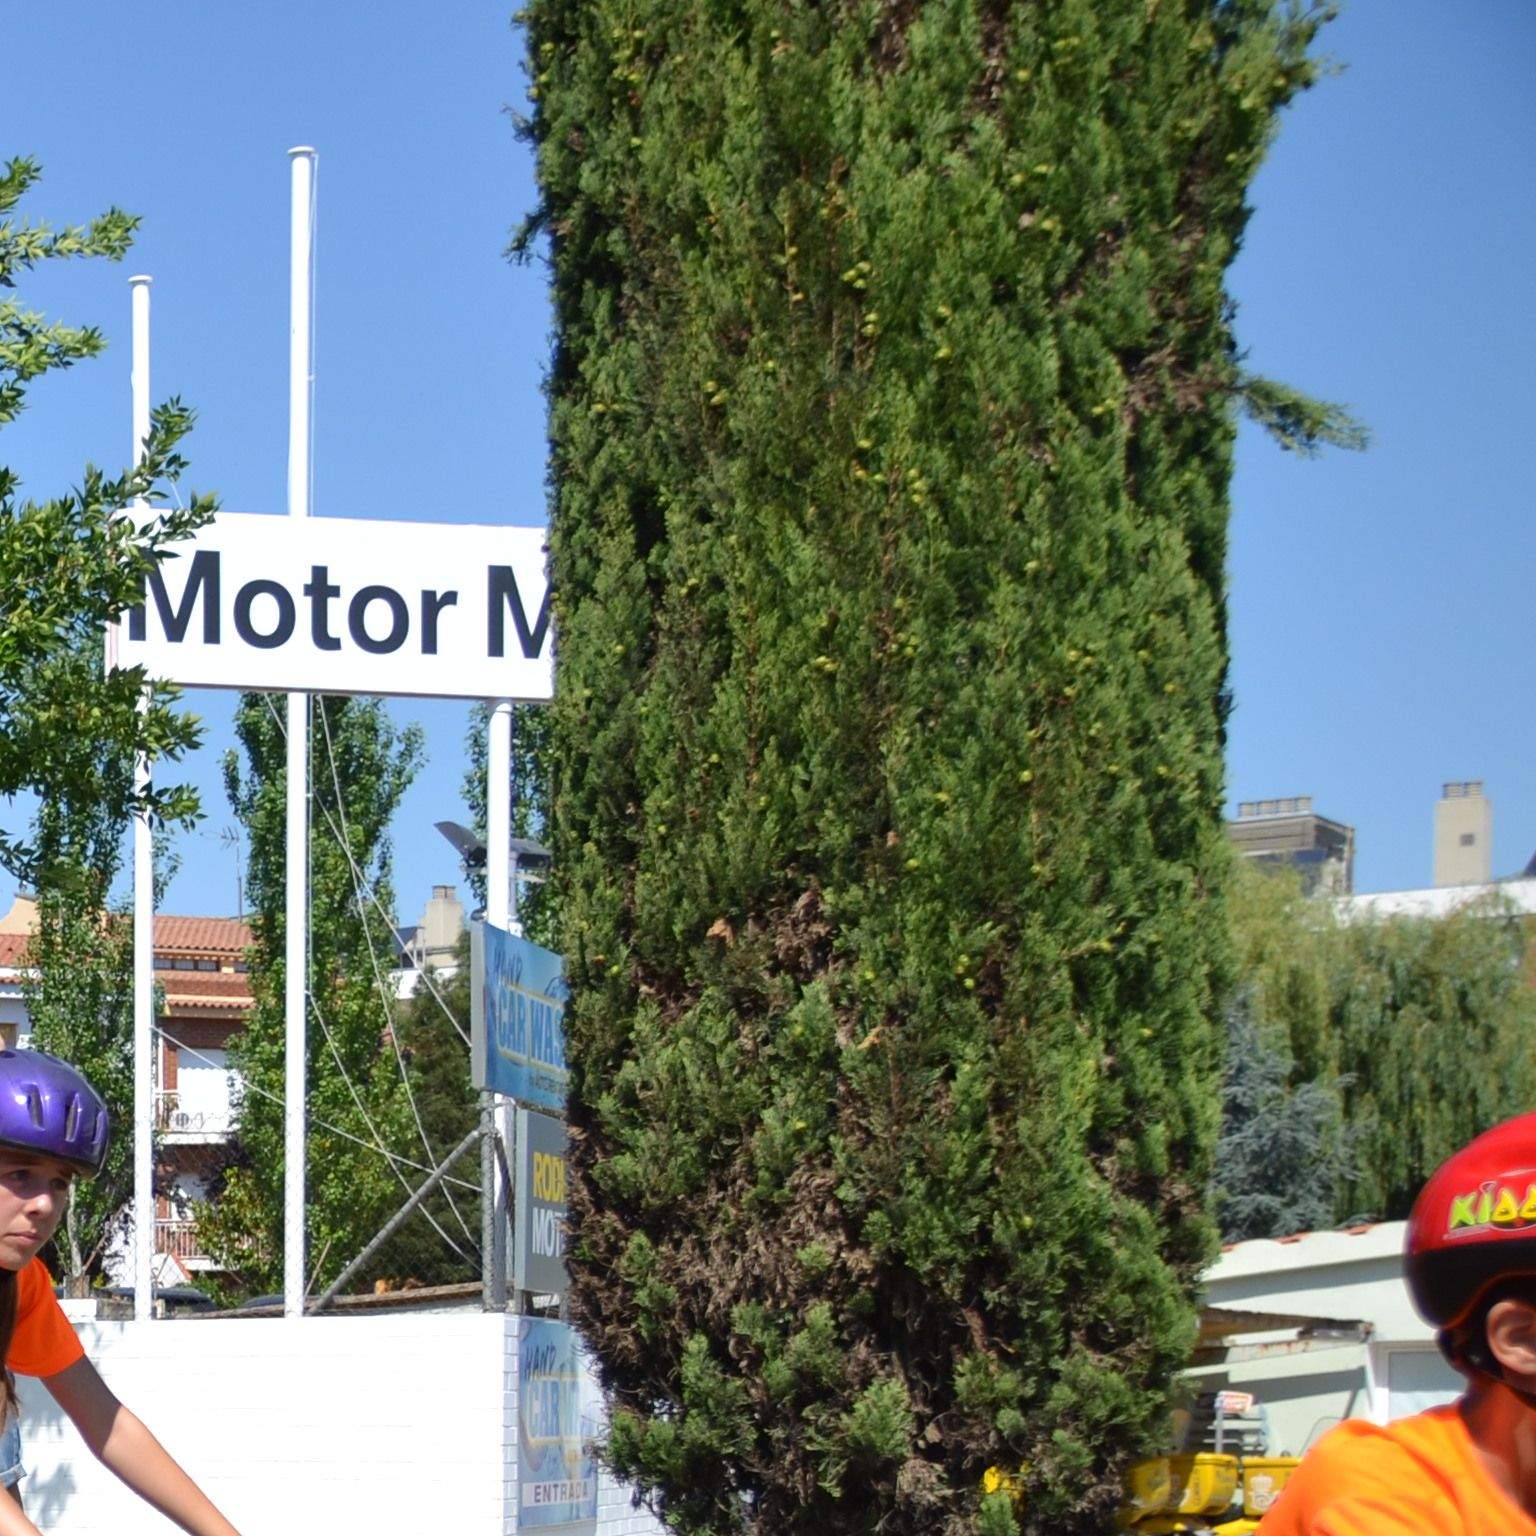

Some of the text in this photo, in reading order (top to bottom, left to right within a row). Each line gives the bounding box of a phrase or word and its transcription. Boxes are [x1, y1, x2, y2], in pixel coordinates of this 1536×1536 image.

[128, 549, 458, 656] Motor
[530, 999, 565, 1070] WAS
[532, 1206, 564, 1258] MOT
[533, 1481, 588, 1504] ENTRADA
